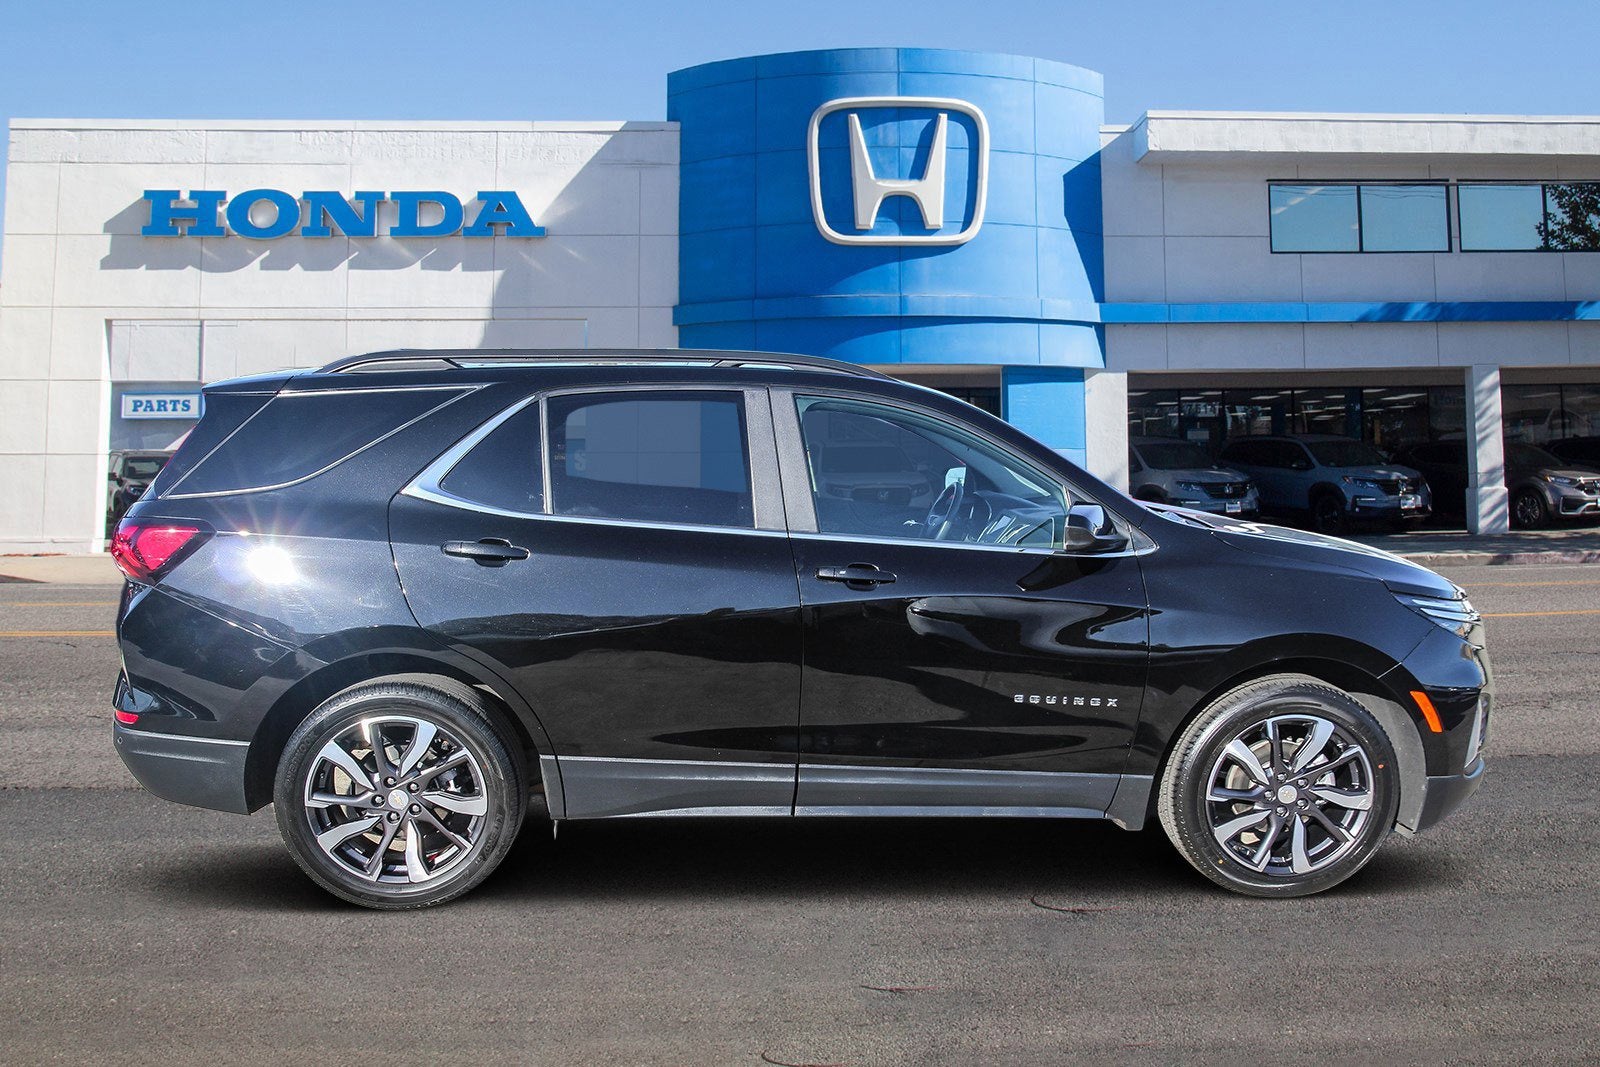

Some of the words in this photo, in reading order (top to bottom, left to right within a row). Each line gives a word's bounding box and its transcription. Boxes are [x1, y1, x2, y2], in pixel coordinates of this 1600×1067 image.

[142, 188, 547, 239] HONDA
[132, 399, 191, 412] PARTS
[1013, 694, 1118, 707] EQUINOX
